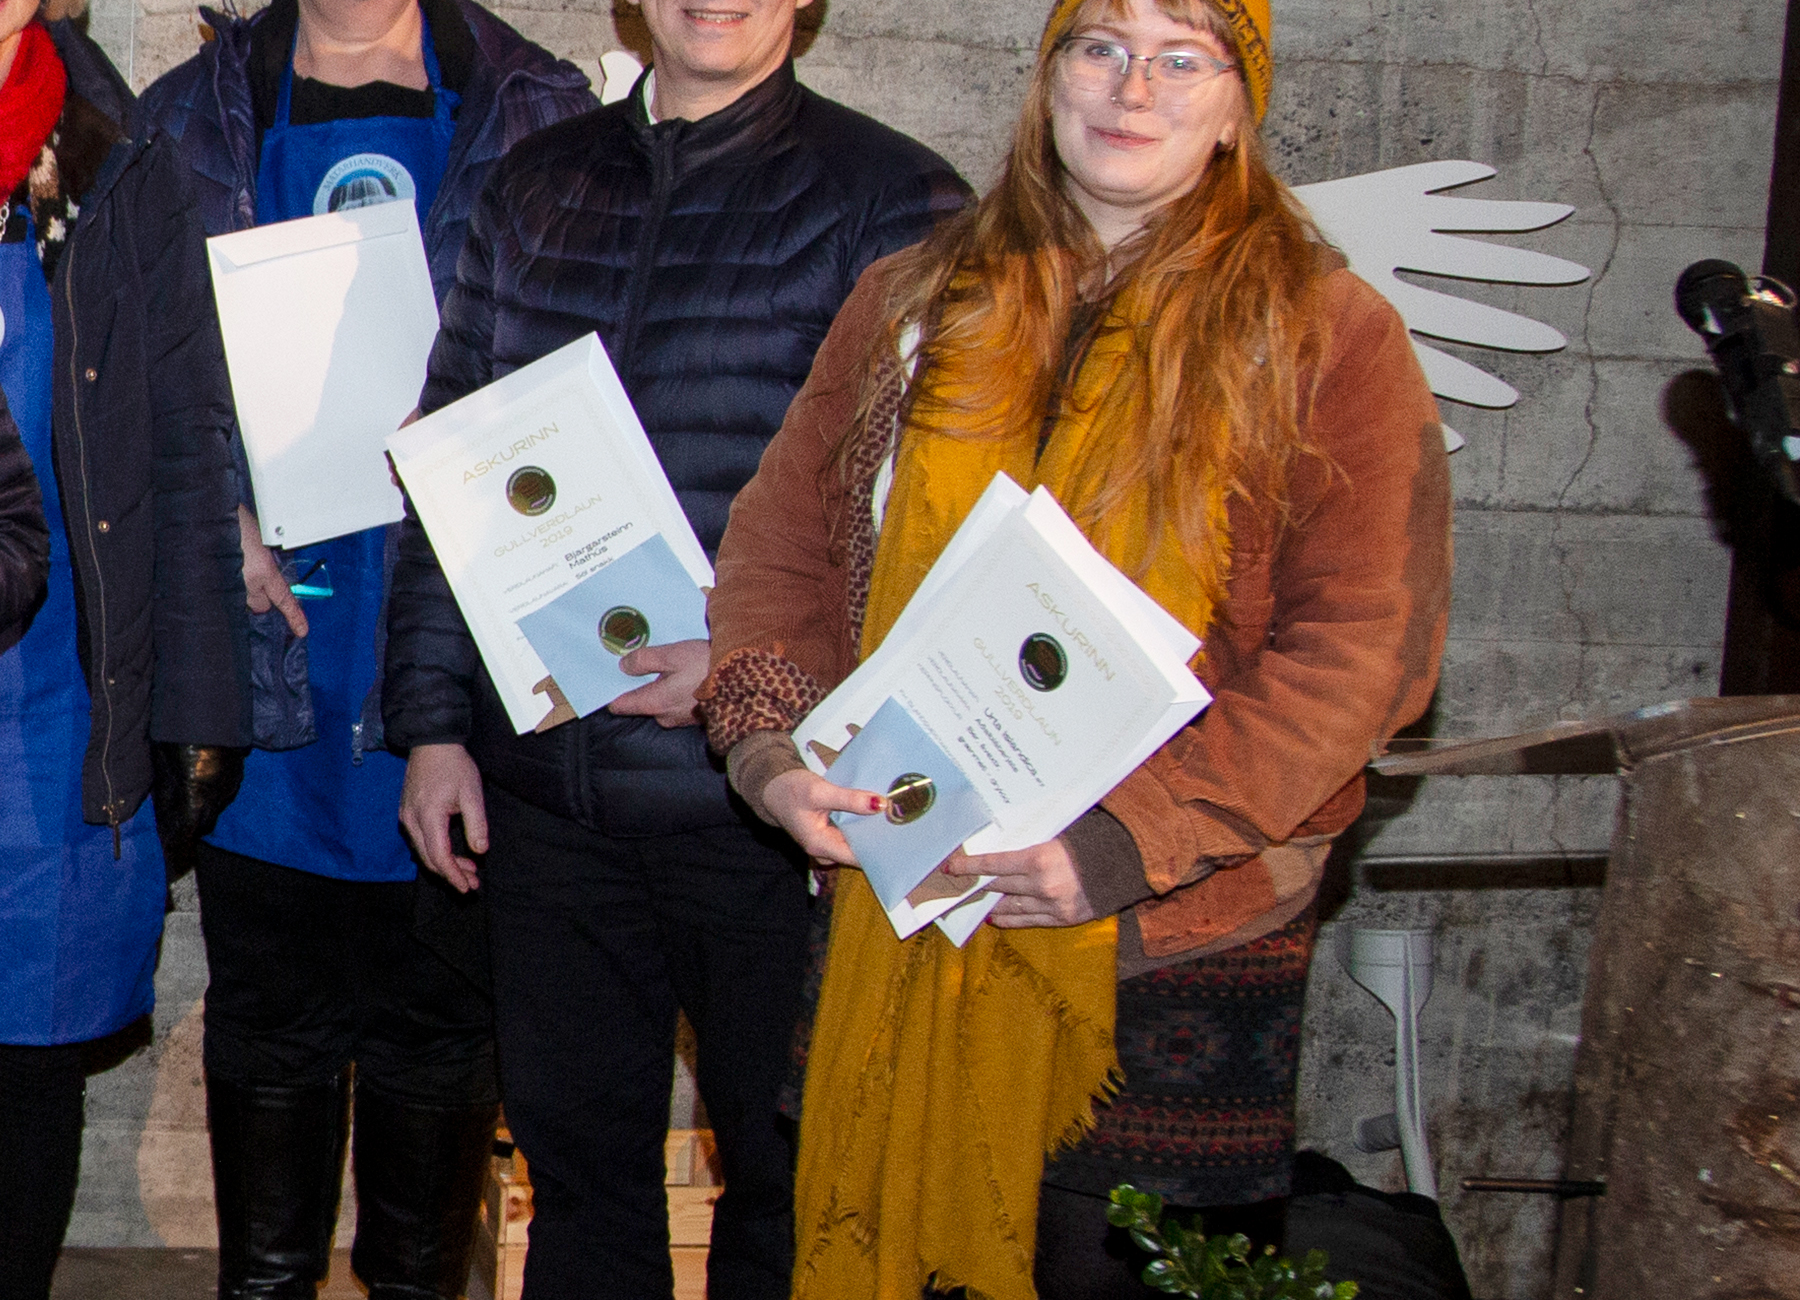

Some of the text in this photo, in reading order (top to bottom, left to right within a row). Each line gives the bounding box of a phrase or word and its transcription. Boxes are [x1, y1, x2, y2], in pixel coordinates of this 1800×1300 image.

[463, 421, 560, 485] ASKURINN
[540, 525, 574, 549] 2019
[564, 521, 634, 563] Bjargarsteinn
[1025, 581, 1117, 682] ASKURINN
[994, 685, 1024, 721] 2019
